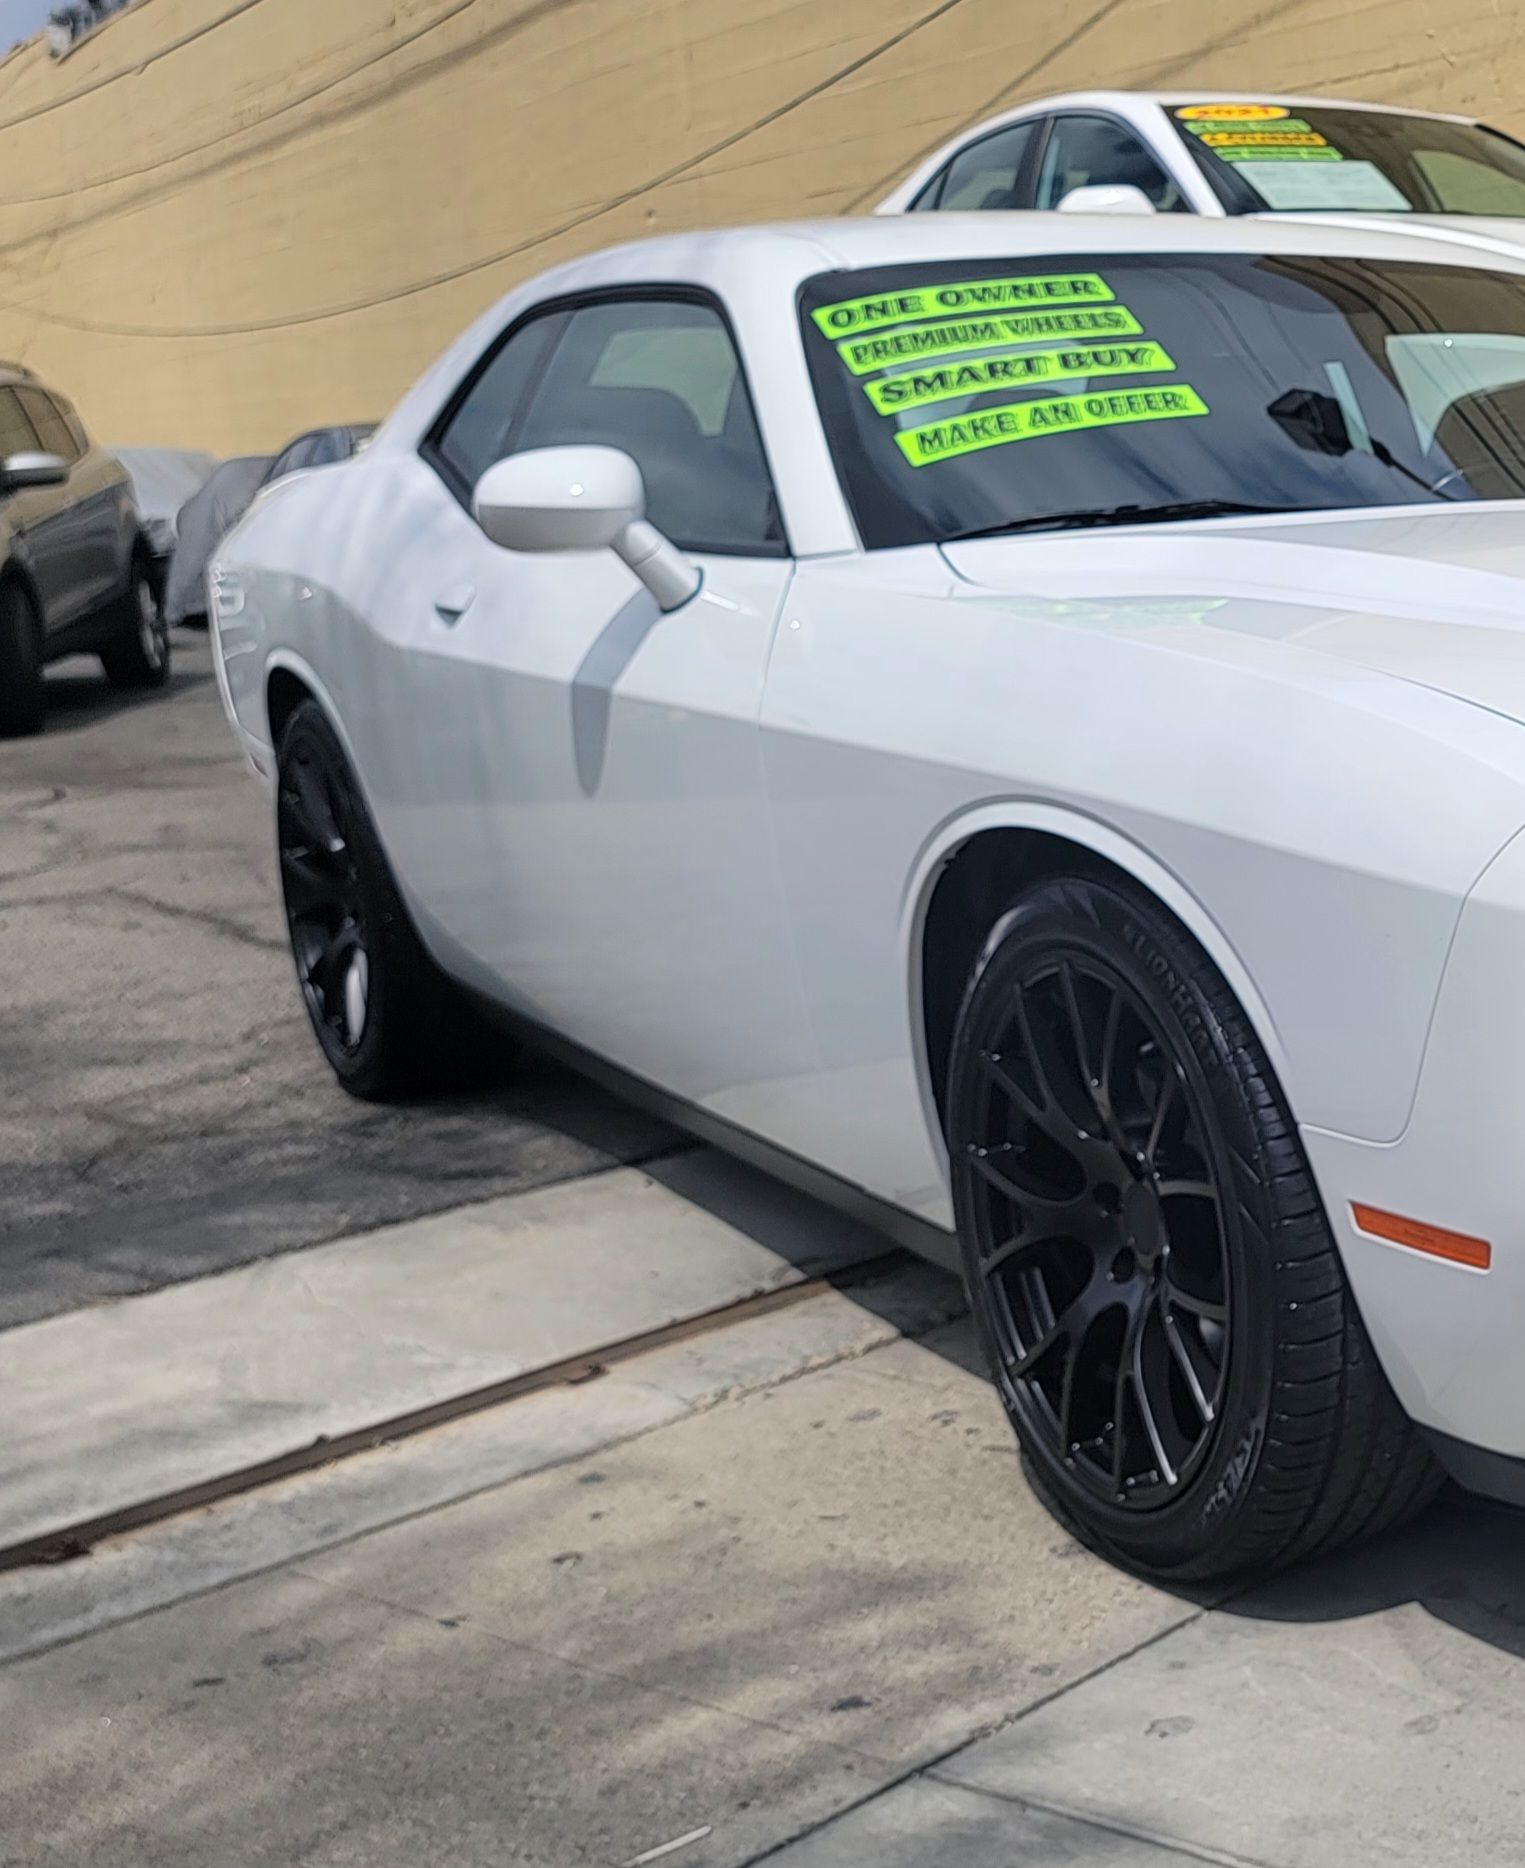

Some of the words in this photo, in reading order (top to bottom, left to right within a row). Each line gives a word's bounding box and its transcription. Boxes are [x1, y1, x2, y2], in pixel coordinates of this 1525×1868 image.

[828, 295, 924, 328] ONE
[936, 280, 1102, 307] OWNER
[852, 322, 1001, 365] PREMIUM
[1002, 311, 1129, 337] WHEELS
[879, 356, 1049, 403] SMART
[1057, 347, 1155, 370] BUY
[916, 411, 1022, 456] MAKE
[1028, 402, 1082, 429] AN
[1084, 391, 1189, 418] OFFER
